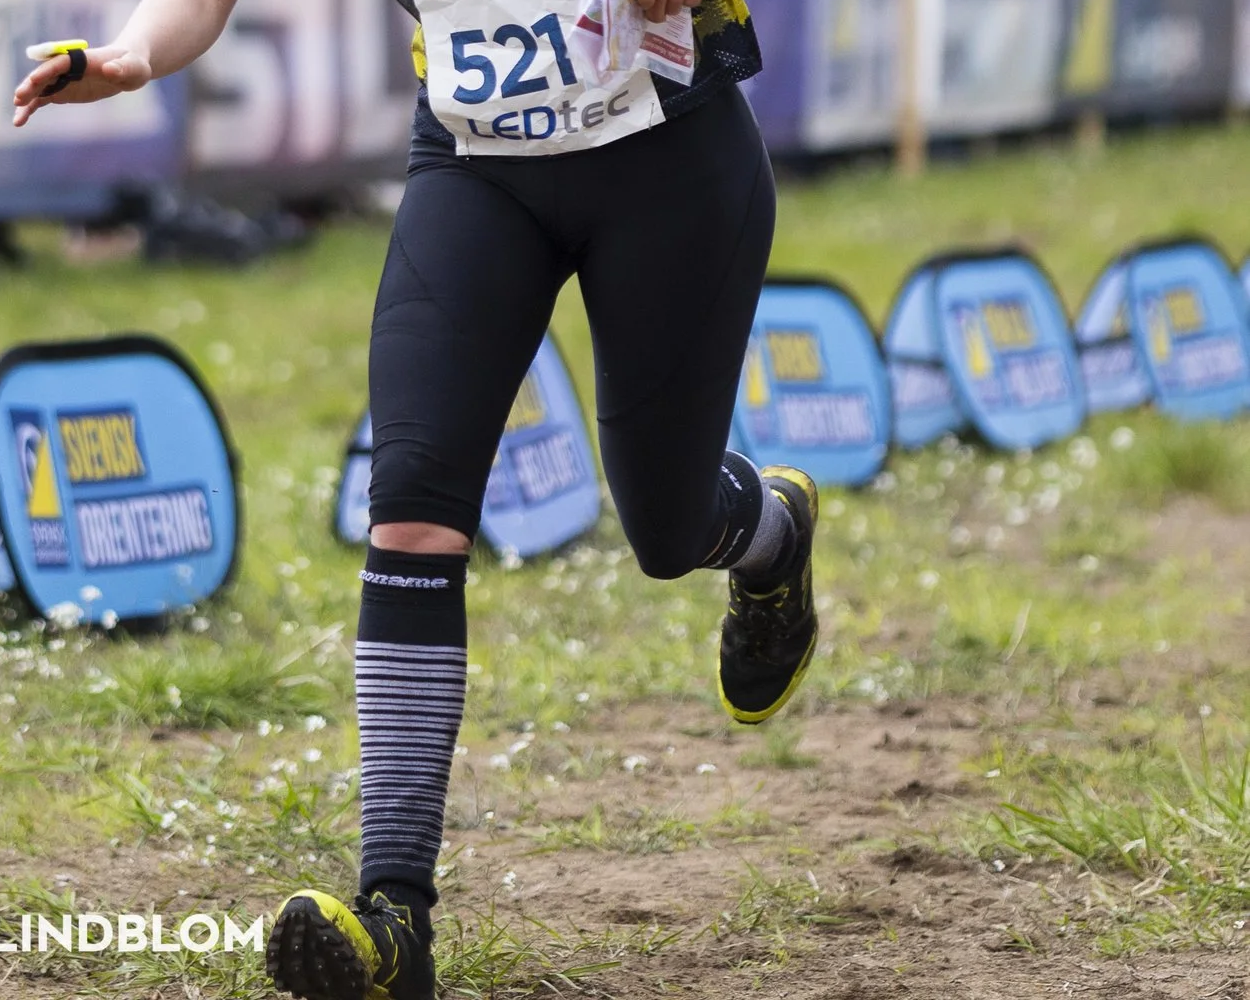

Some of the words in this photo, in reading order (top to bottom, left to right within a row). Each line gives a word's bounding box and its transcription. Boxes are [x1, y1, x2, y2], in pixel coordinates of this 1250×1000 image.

[450, 13, 578, 105] 521
[465, 89, 630, 141] LEDtec
[59, 415, 145, 482] SVENSK
[75, 489, 213, 568] ORIENTERING
